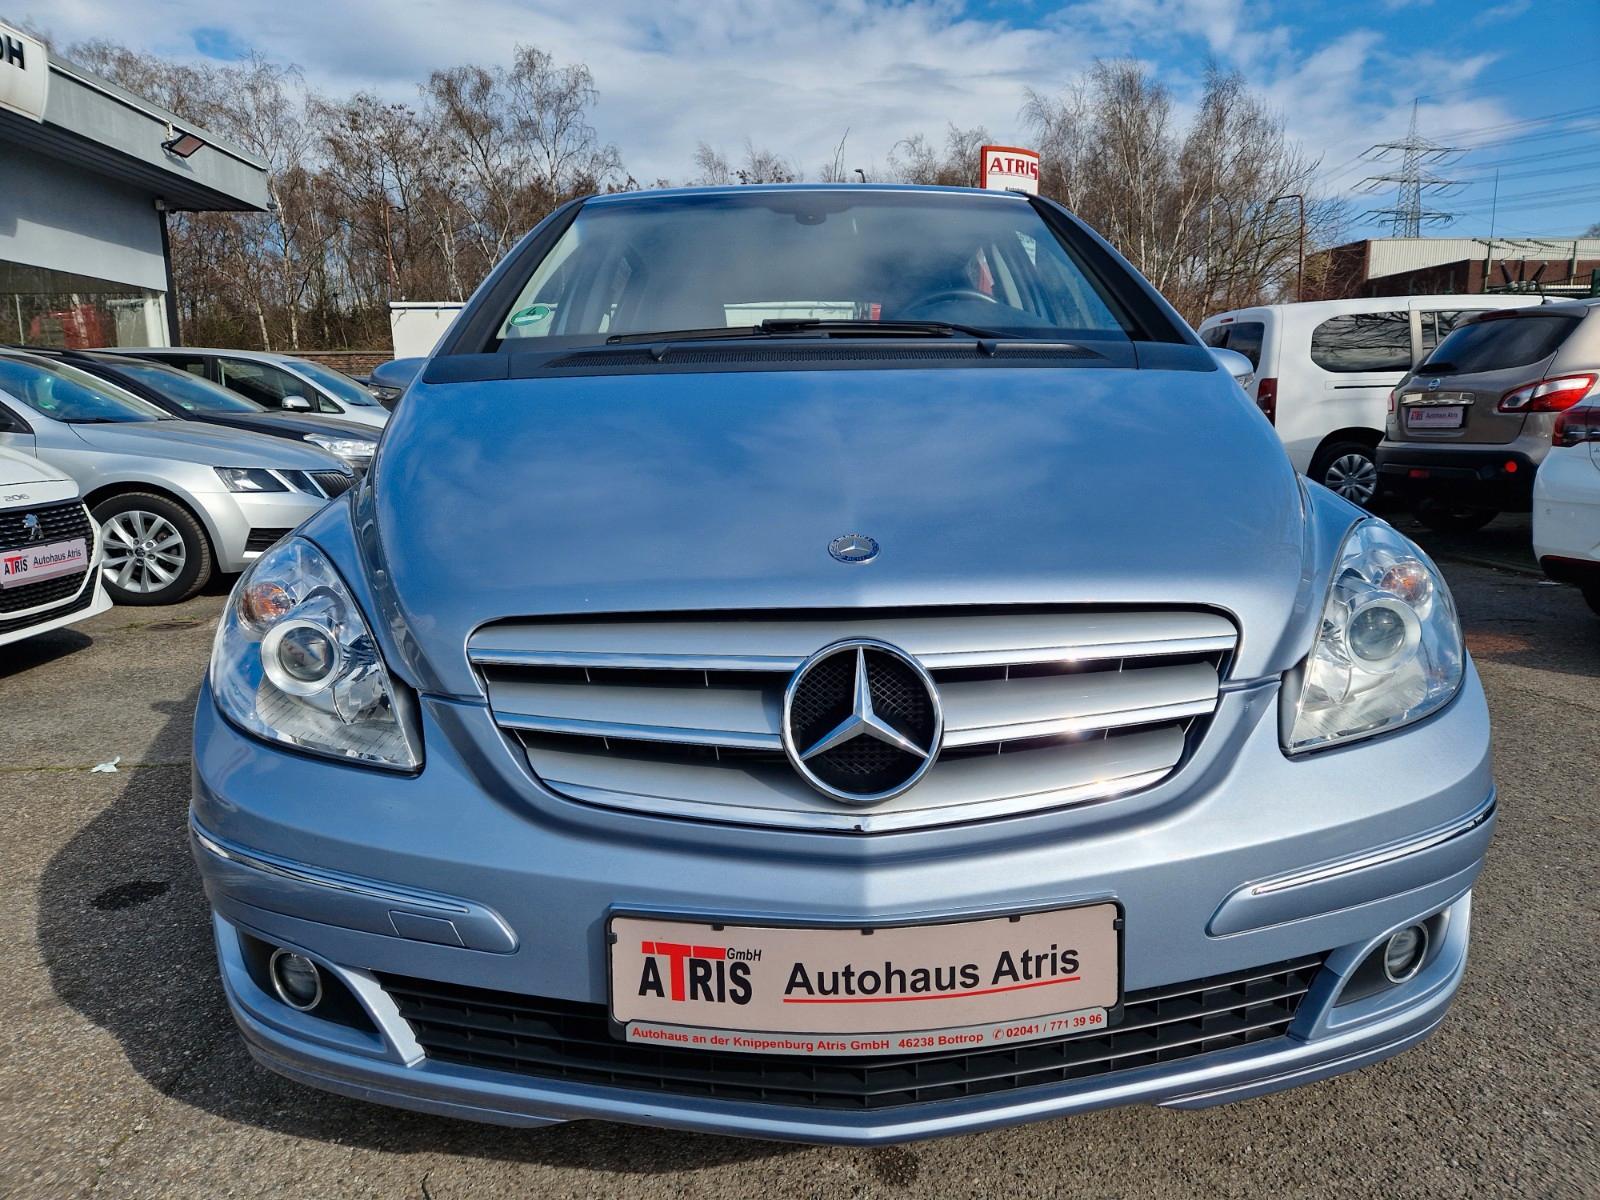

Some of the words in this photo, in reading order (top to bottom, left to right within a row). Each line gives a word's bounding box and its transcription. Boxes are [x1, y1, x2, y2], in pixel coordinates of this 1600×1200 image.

[990, 157, 1038, 180] ATRIS
[4, 556, 28, 575] ATRIS
[33, 552, 66, 566] Autohaus
[67, 548, 82, 558] Atris
[726, 947, 762, 962] GmbH
[638, 941, 753, 1006] ATRIS
[784, 961, 980, 996] Autohaus
[992, 944, 1080, 985] Atris
[632, 1026, 689, 1043] Autohaus
[692, 1035, 708, 1045] an
[710, 1034, 730, 1046] der
[733, 1036, 814, 1052] Knippenburg
[817, 1040, 847, 1051] Atris
[850, 1039, 890, 1051] GmbH
[898, 1037, 935, 1049] 46238
[938, 1033, 984, 1046] Bottrop
[1006, 1024, 1040, 1038] 02041
[1050, 1020, 1069, 1031] 771
[1073, 1016, 1086, 1027] 39
[1089, 1014, 1102, 1025] 96
